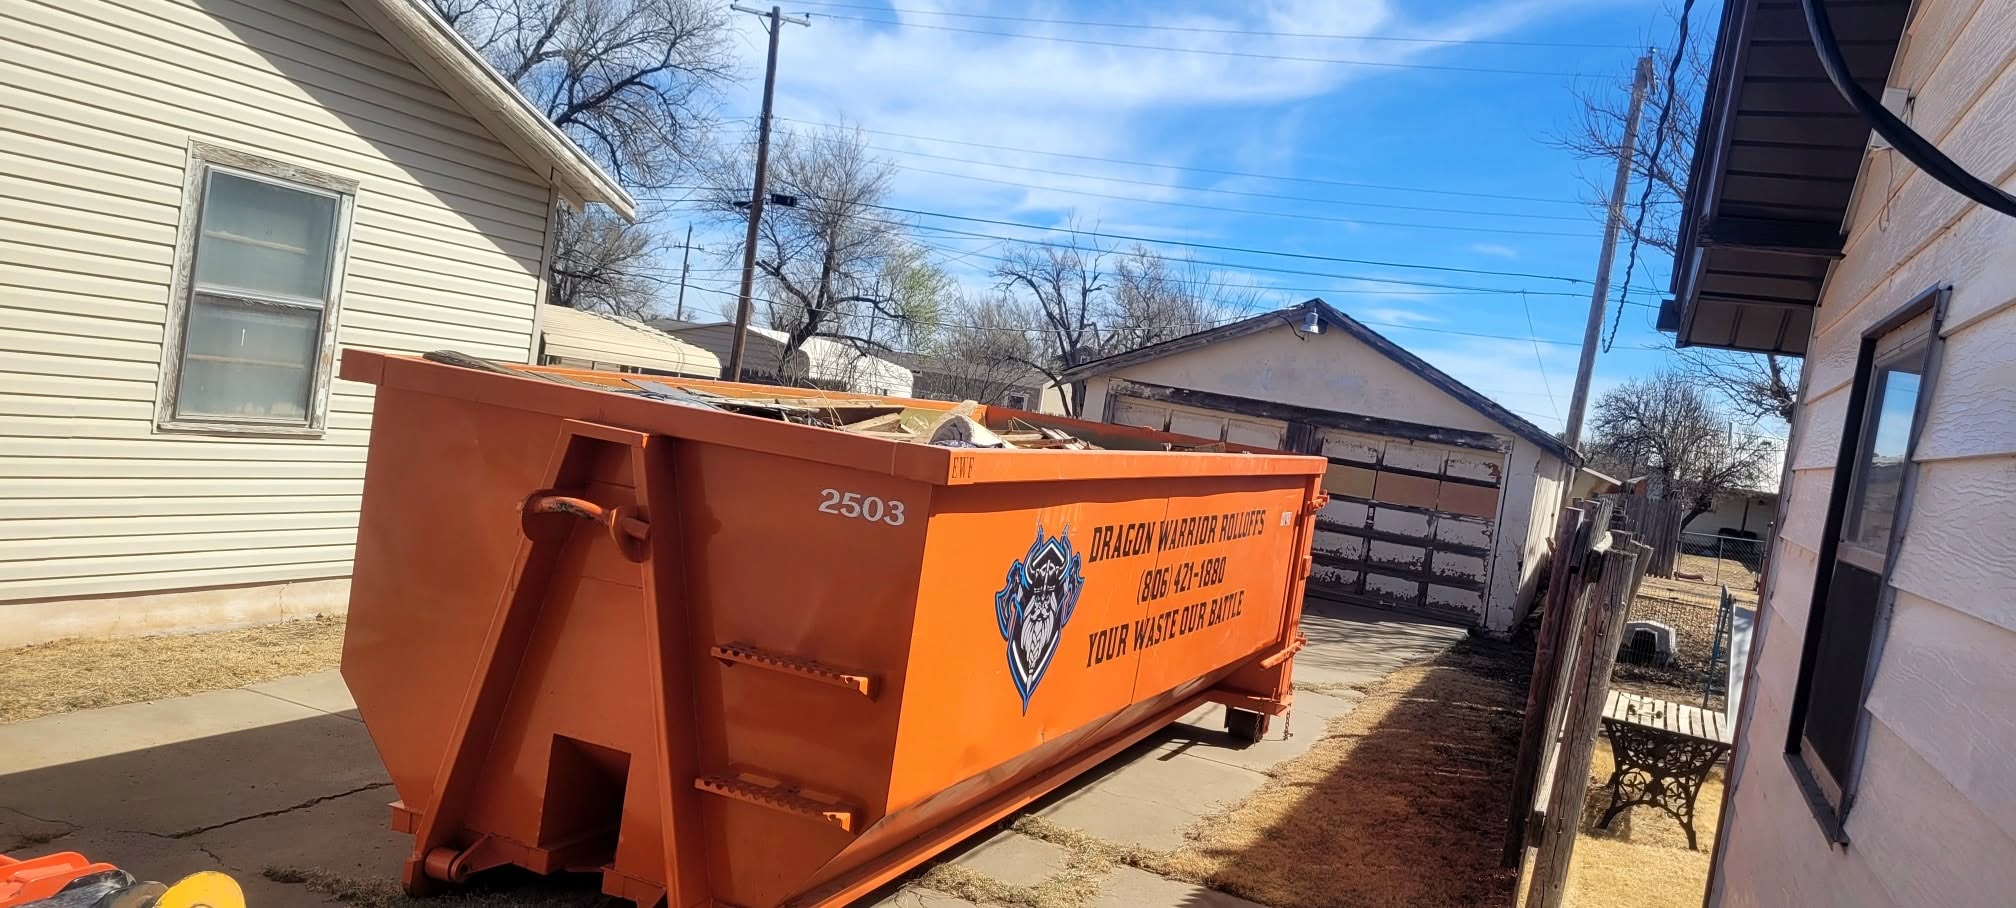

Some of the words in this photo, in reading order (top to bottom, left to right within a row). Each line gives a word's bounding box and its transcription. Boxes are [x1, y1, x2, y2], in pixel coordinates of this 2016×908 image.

[951, 456, 975, 479] EWF
[818, 488, 905, 526] 2503
[1088, 521, 1156, 563] DRAGON
[1158, 513, 1218, 552] WARRIOR
[1219, 509, 1266, 541] ROLLOFFS
[1136, 564, 1173, 605] (806)
[1173, 556, 1227, 593] 421-1880
[1086, 623, 1130, 668] YOUR
[1133, 609, 1179, 652] WASTE
[1179, 601, 1206, 635] OUR
[1207, 590, 1245, 627] BATTLE
